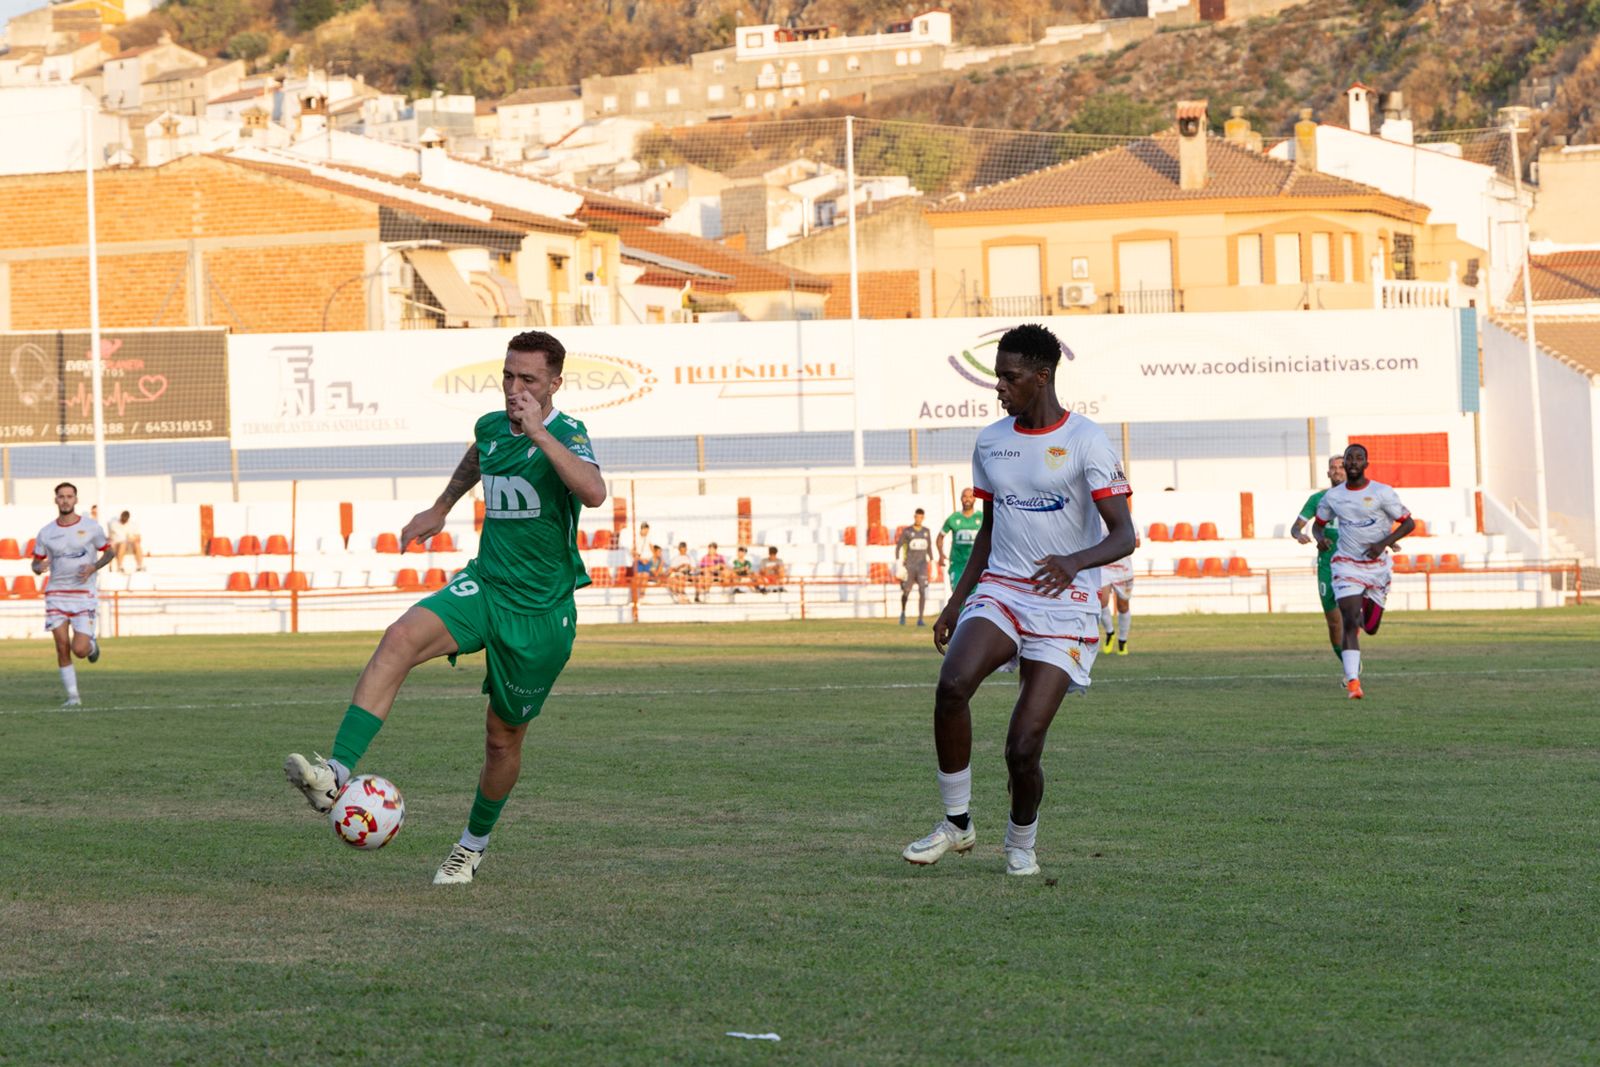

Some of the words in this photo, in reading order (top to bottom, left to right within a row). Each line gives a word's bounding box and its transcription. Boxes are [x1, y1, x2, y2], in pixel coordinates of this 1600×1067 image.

[1140, 354, 1420, 377] www.acodisiniciativas.com
[919, 399, 989, 419] Acodis
[145, 419, 213, 434] 645310153
[1005, 494, 1046, 508] Bonilla
